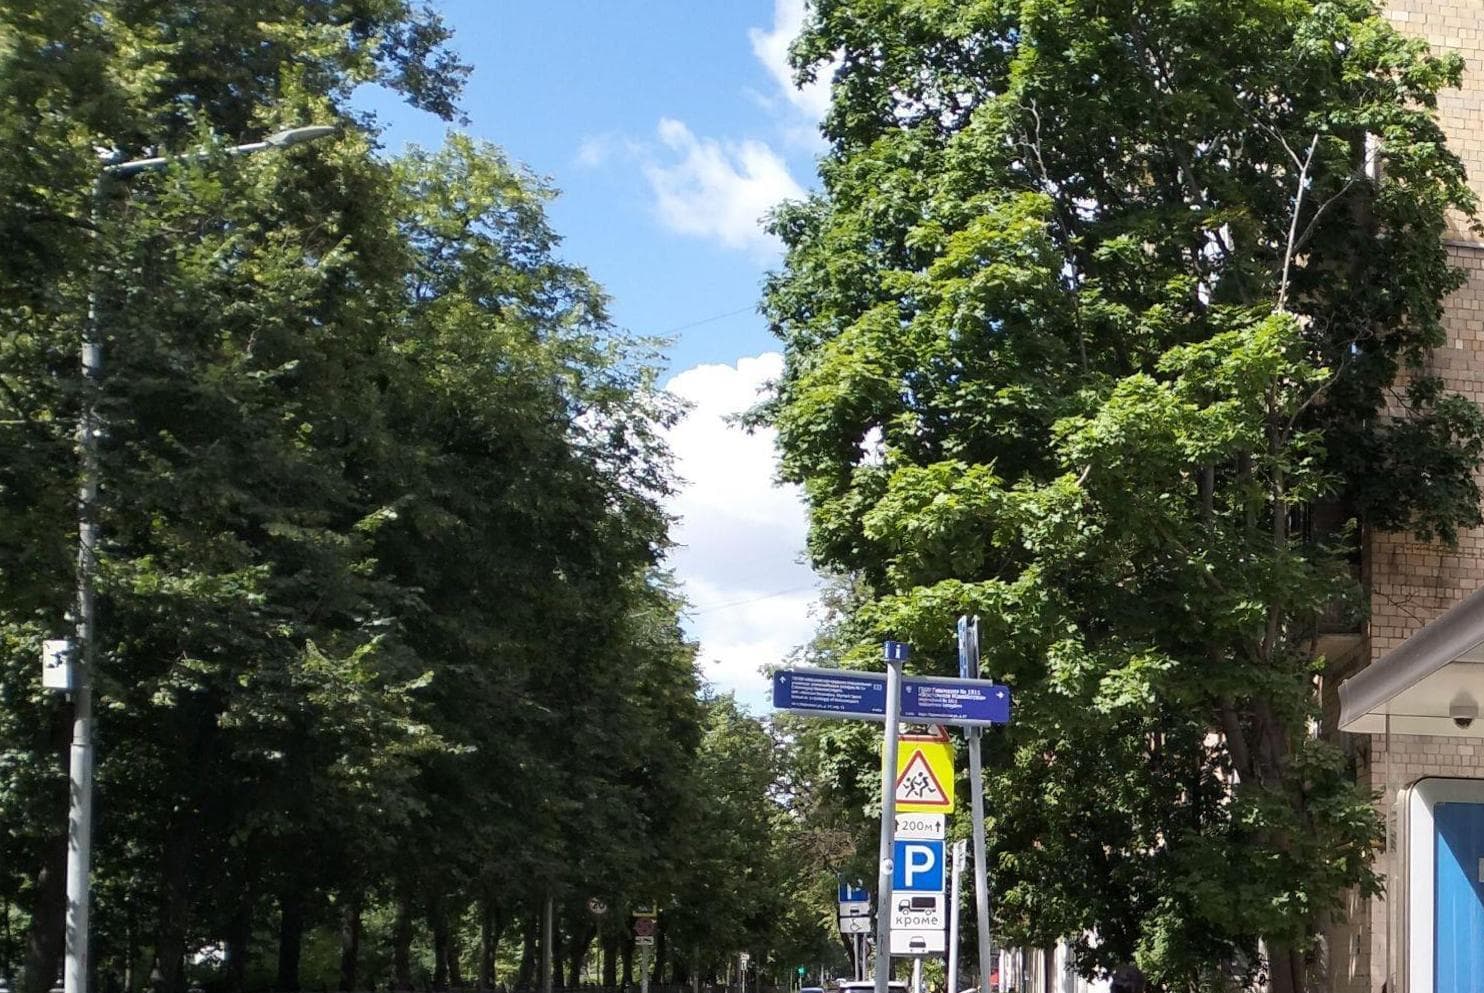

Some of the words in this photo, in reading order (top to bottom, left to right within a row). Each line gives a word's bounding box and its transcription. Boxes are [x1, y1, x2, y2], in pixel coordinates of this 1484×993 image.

[902, 821, 933, 832] 200м
[905, 845, 935, 887] P
[896, 916, 939, 927] кроме
